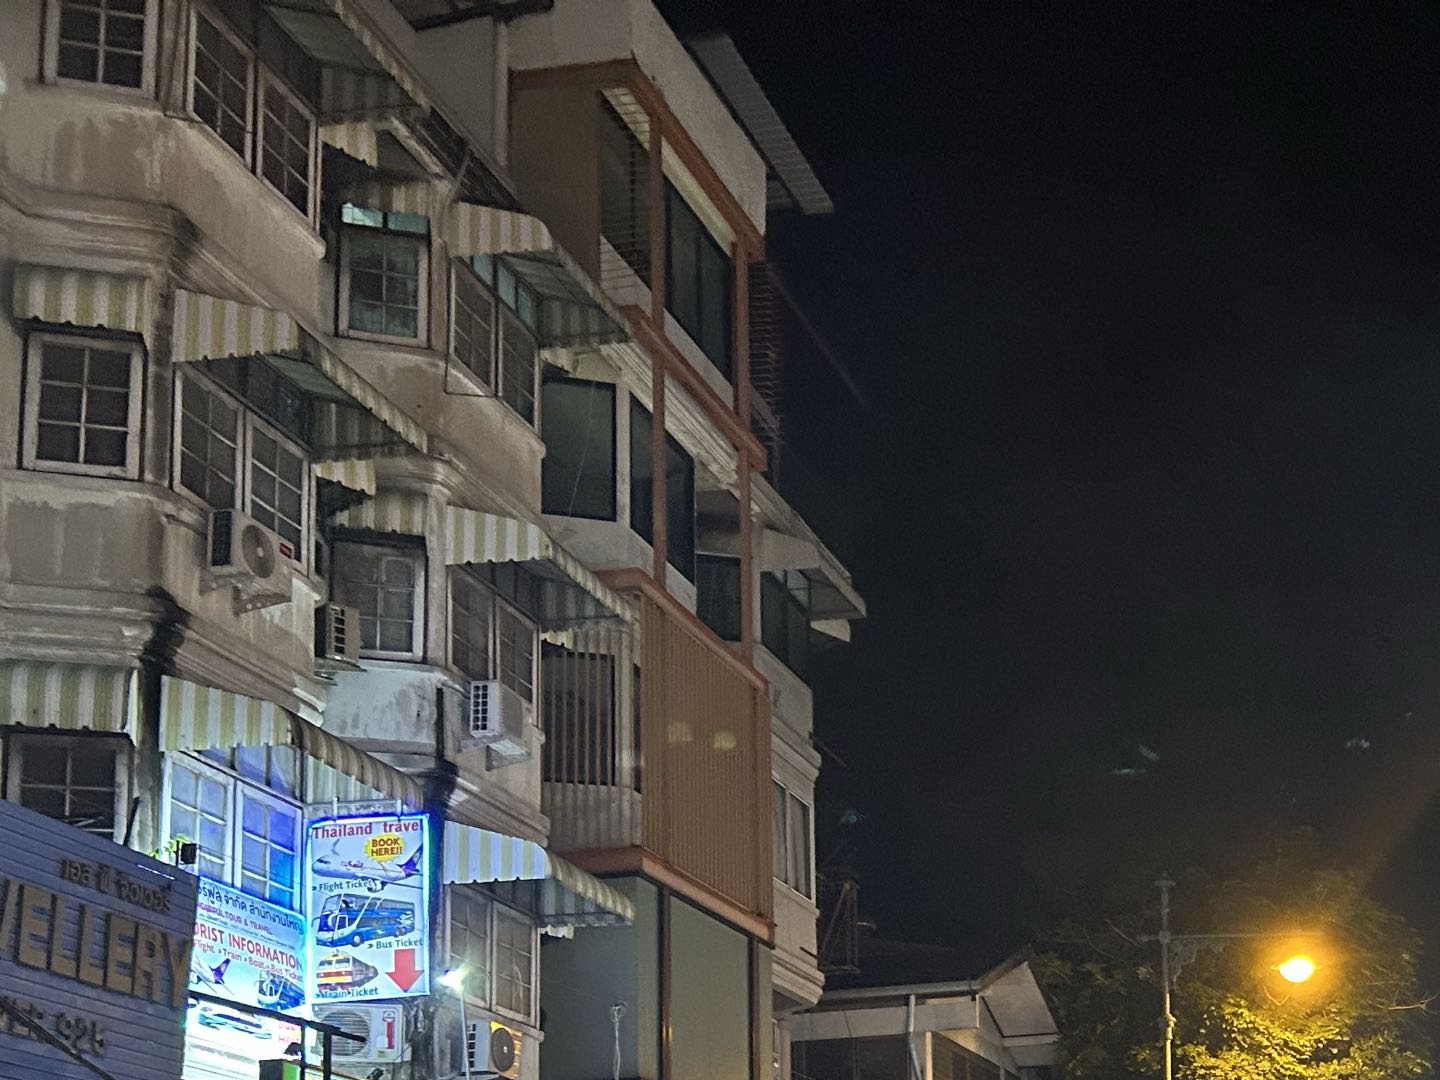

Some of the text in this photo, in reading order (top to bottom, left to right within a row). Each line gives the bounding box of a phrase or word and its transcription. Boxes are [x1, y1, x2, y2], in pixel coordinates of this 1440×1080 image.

[313, 822, 373, 839] Thailand
[372, 838, 400, 847] BOOK
[319, 880, 373, 892] Flight Ticket
[376, 938, 424, 949] Bus Ticket
[351, 988, 379, 998] Ticket
